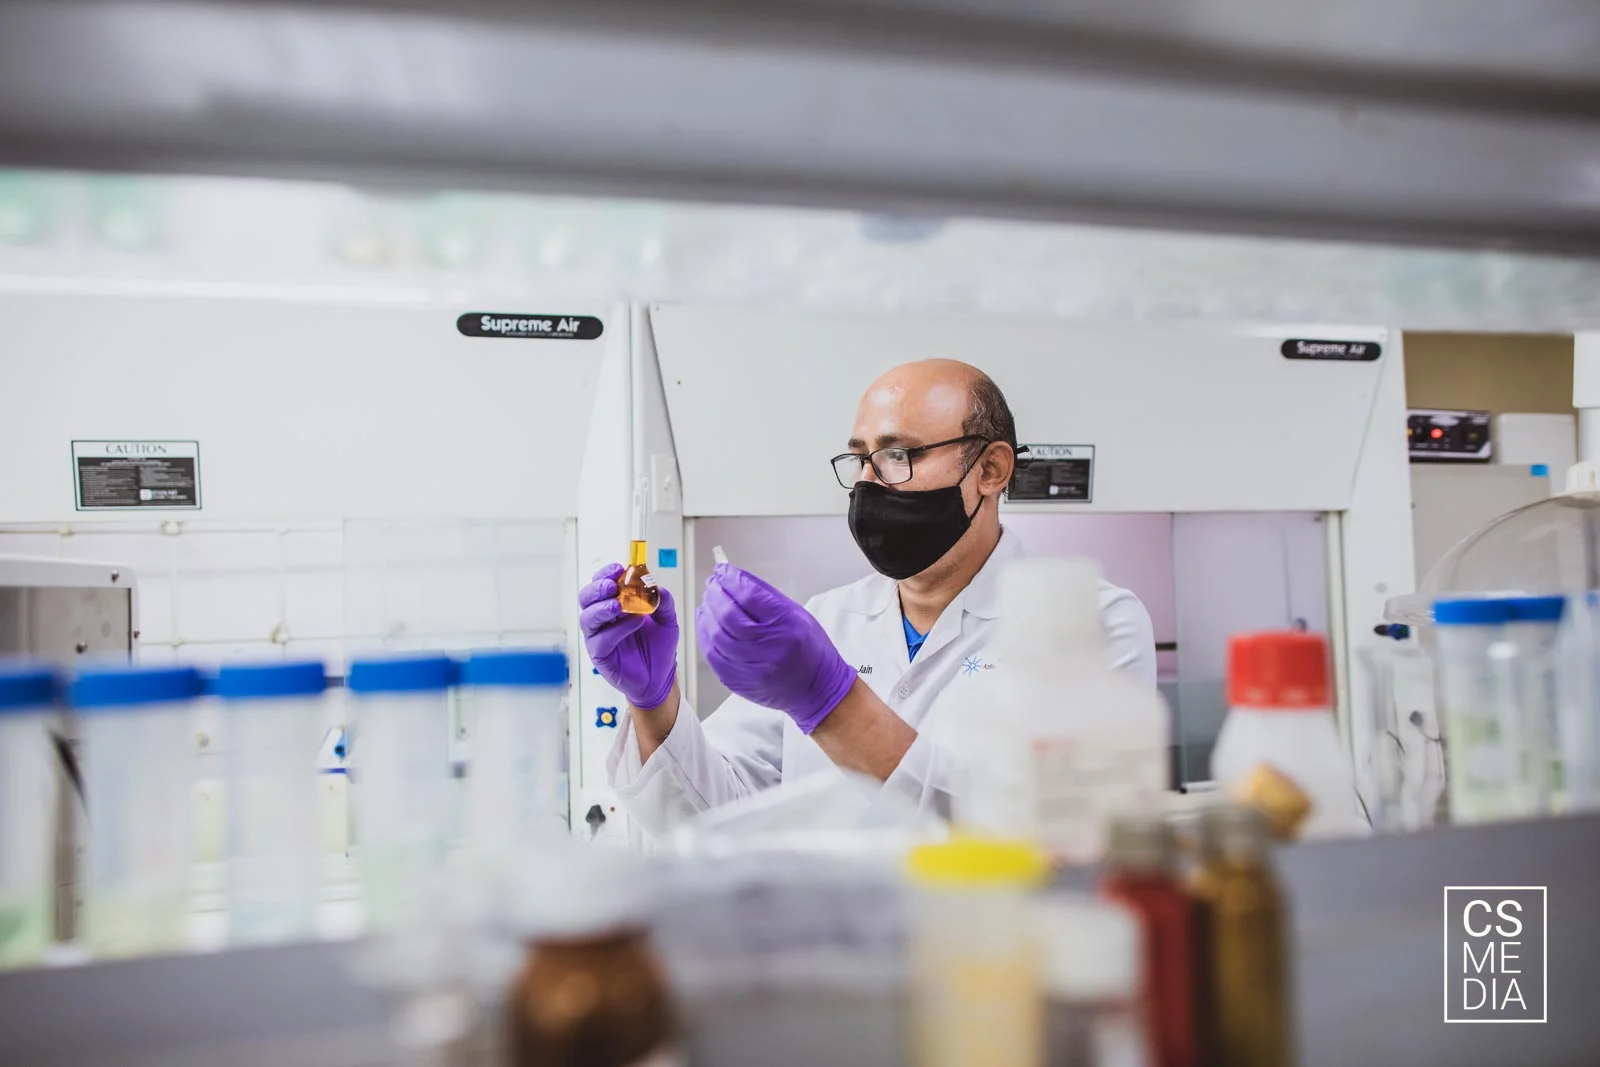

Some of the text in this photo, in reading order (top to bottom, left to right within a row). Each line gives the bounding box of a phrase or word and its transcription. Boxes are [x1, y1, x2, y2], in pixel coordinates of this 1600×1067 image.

[480, 315, 580, 333] Supreme Air
[1296, 341, 1366, 356] Supreme Air
[105, 443, 168, 455] CAUTION
